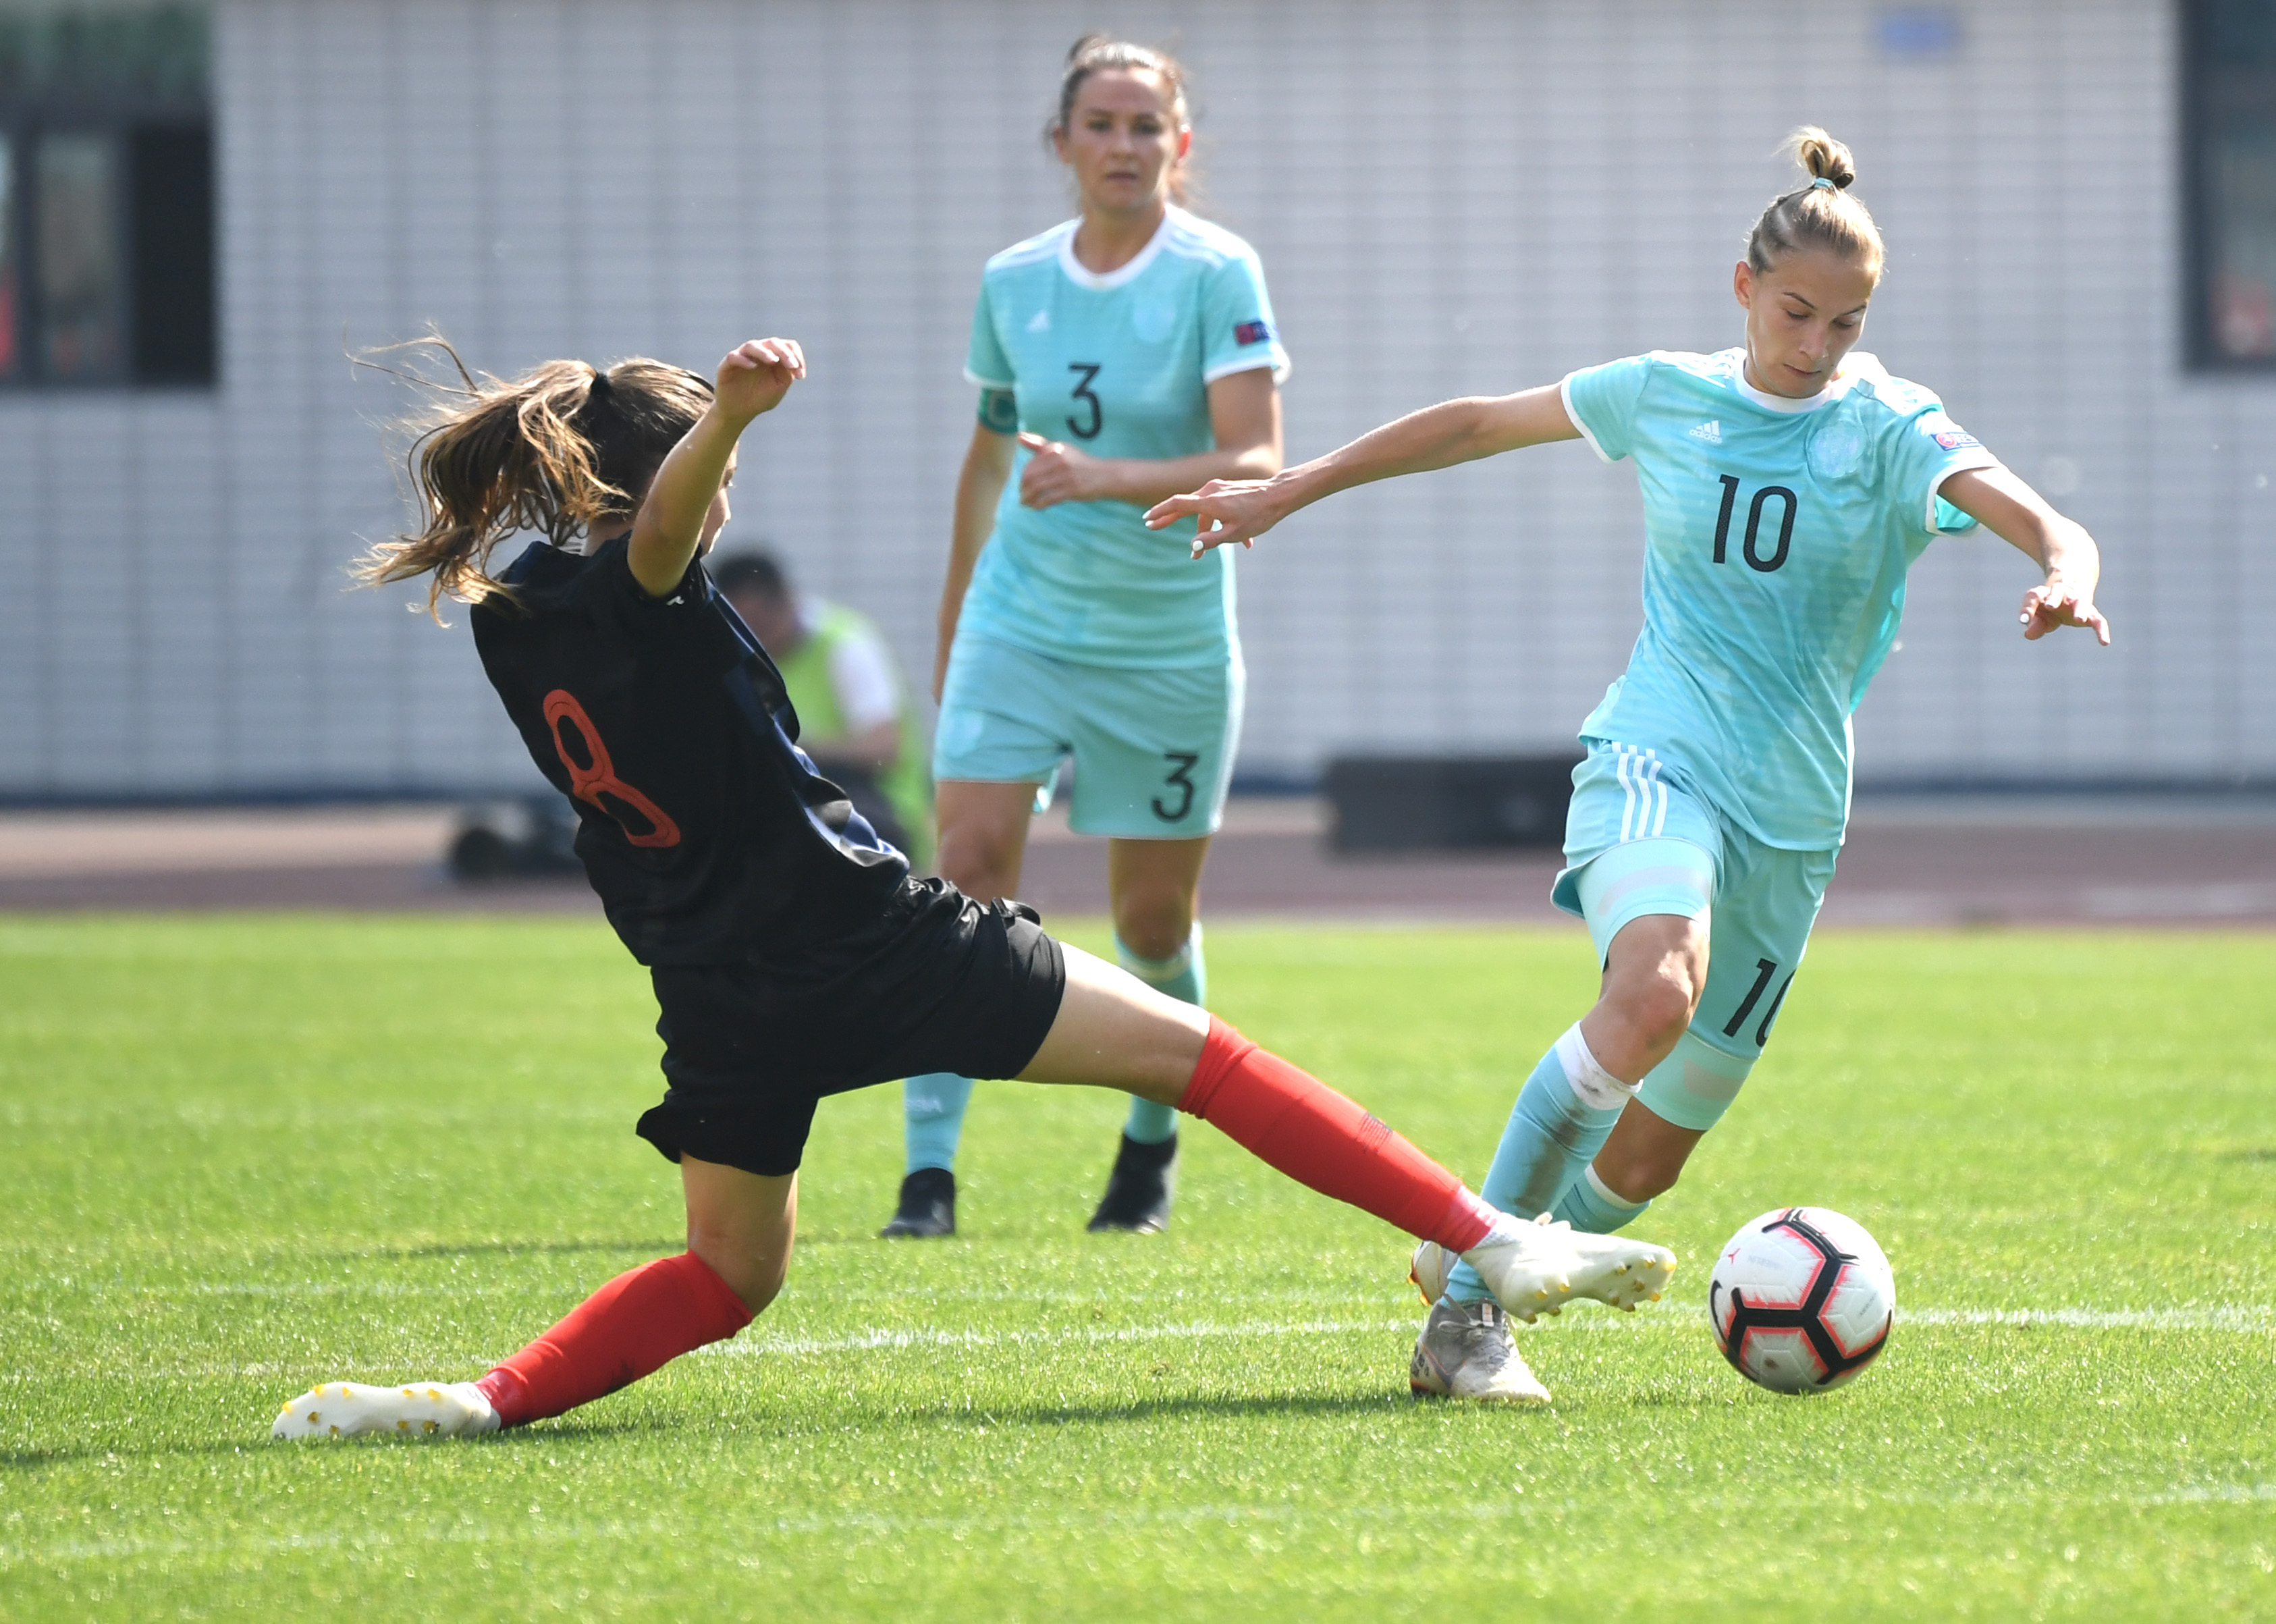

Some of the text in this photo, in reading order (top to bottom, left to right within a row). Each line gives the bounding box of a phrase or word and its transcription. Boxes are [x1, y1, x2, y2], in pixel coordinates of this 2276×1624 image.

[1066, 362, 1102, 440] 3
[1689, 428, 1723, 443] adidas
[1712, 473, 1798, 573] 10
[543, 689, 681, 847] 8
[1151, 751, 1200, 823] 3
